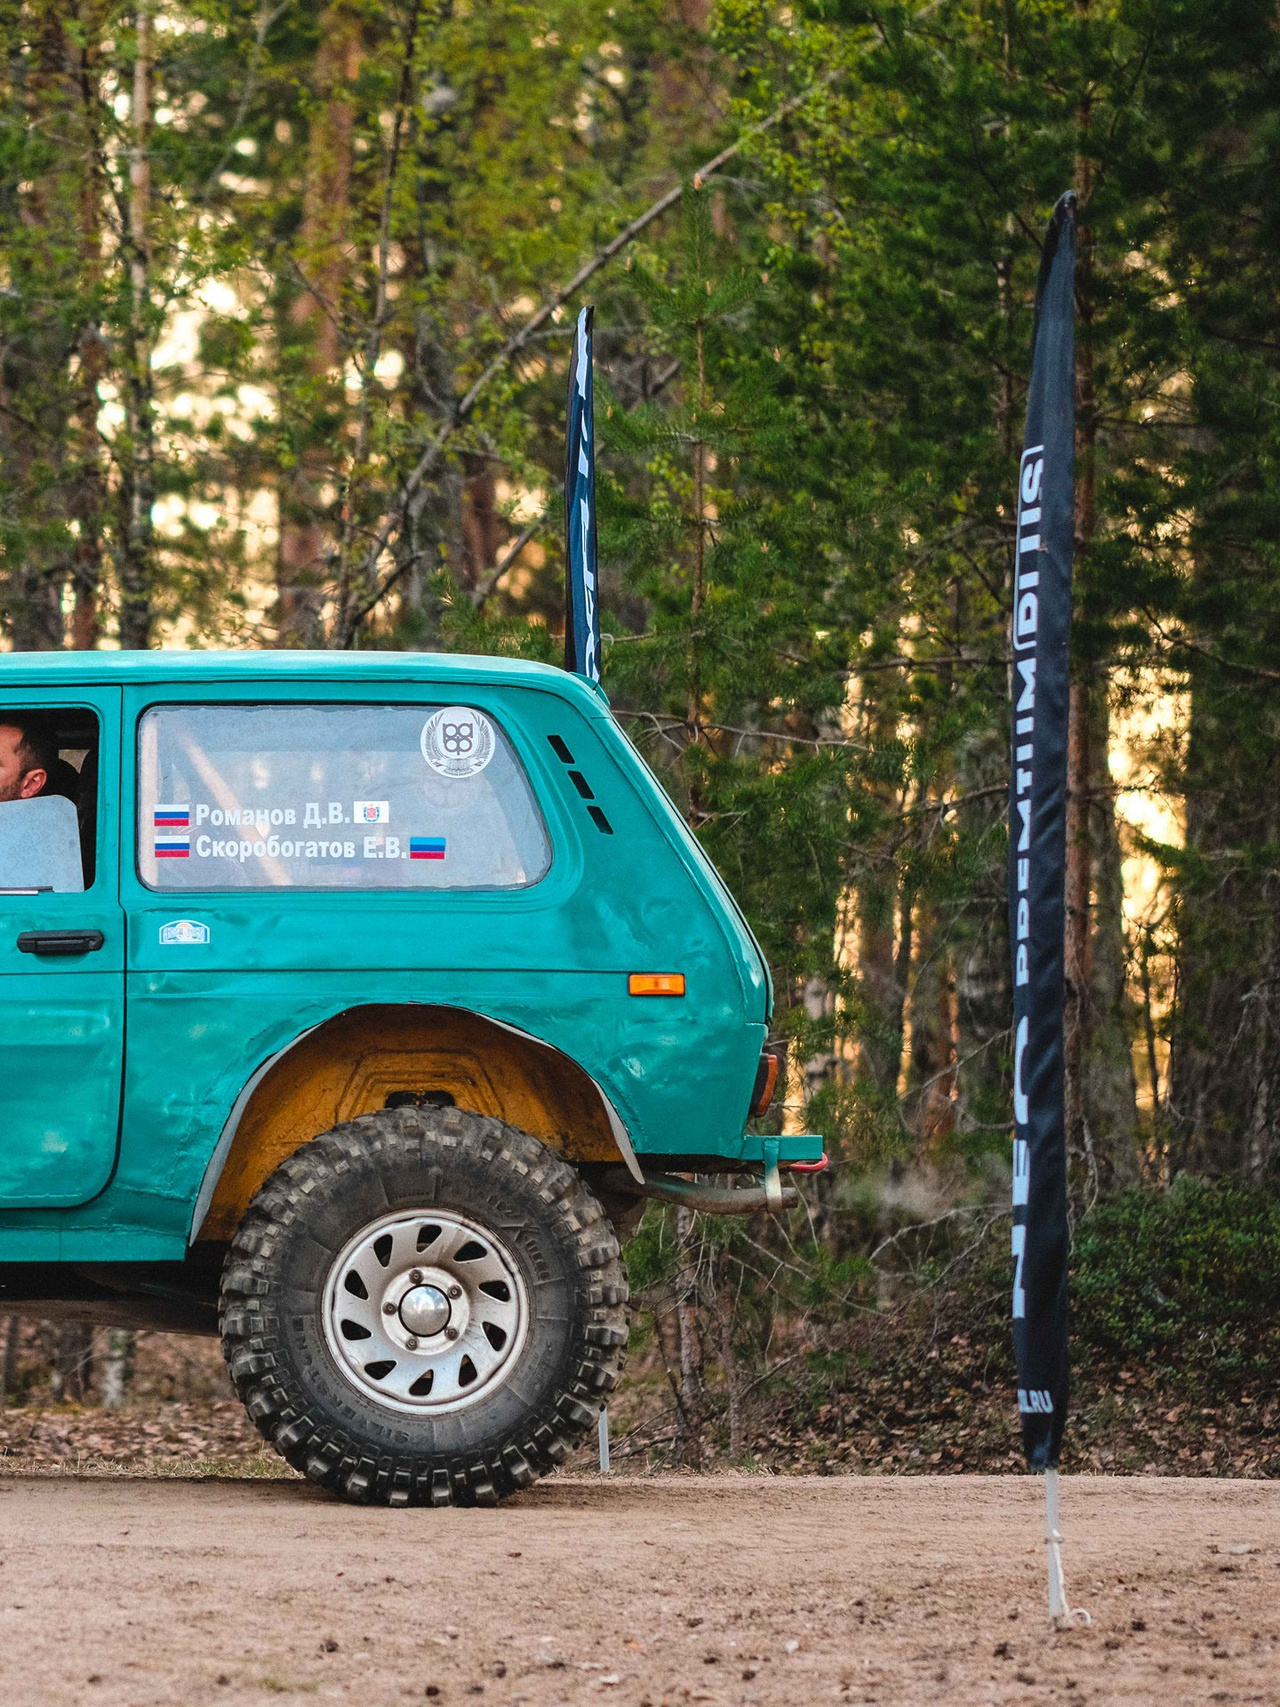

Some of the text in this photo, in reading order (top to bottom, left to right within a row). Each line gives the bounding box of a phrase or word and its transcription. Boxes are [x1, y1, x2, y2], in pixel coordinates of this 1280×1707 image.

[195, 802, 351, 829] Романов Д.В.
[195, 834, 407, 863] Скоробогатов Е.В.
